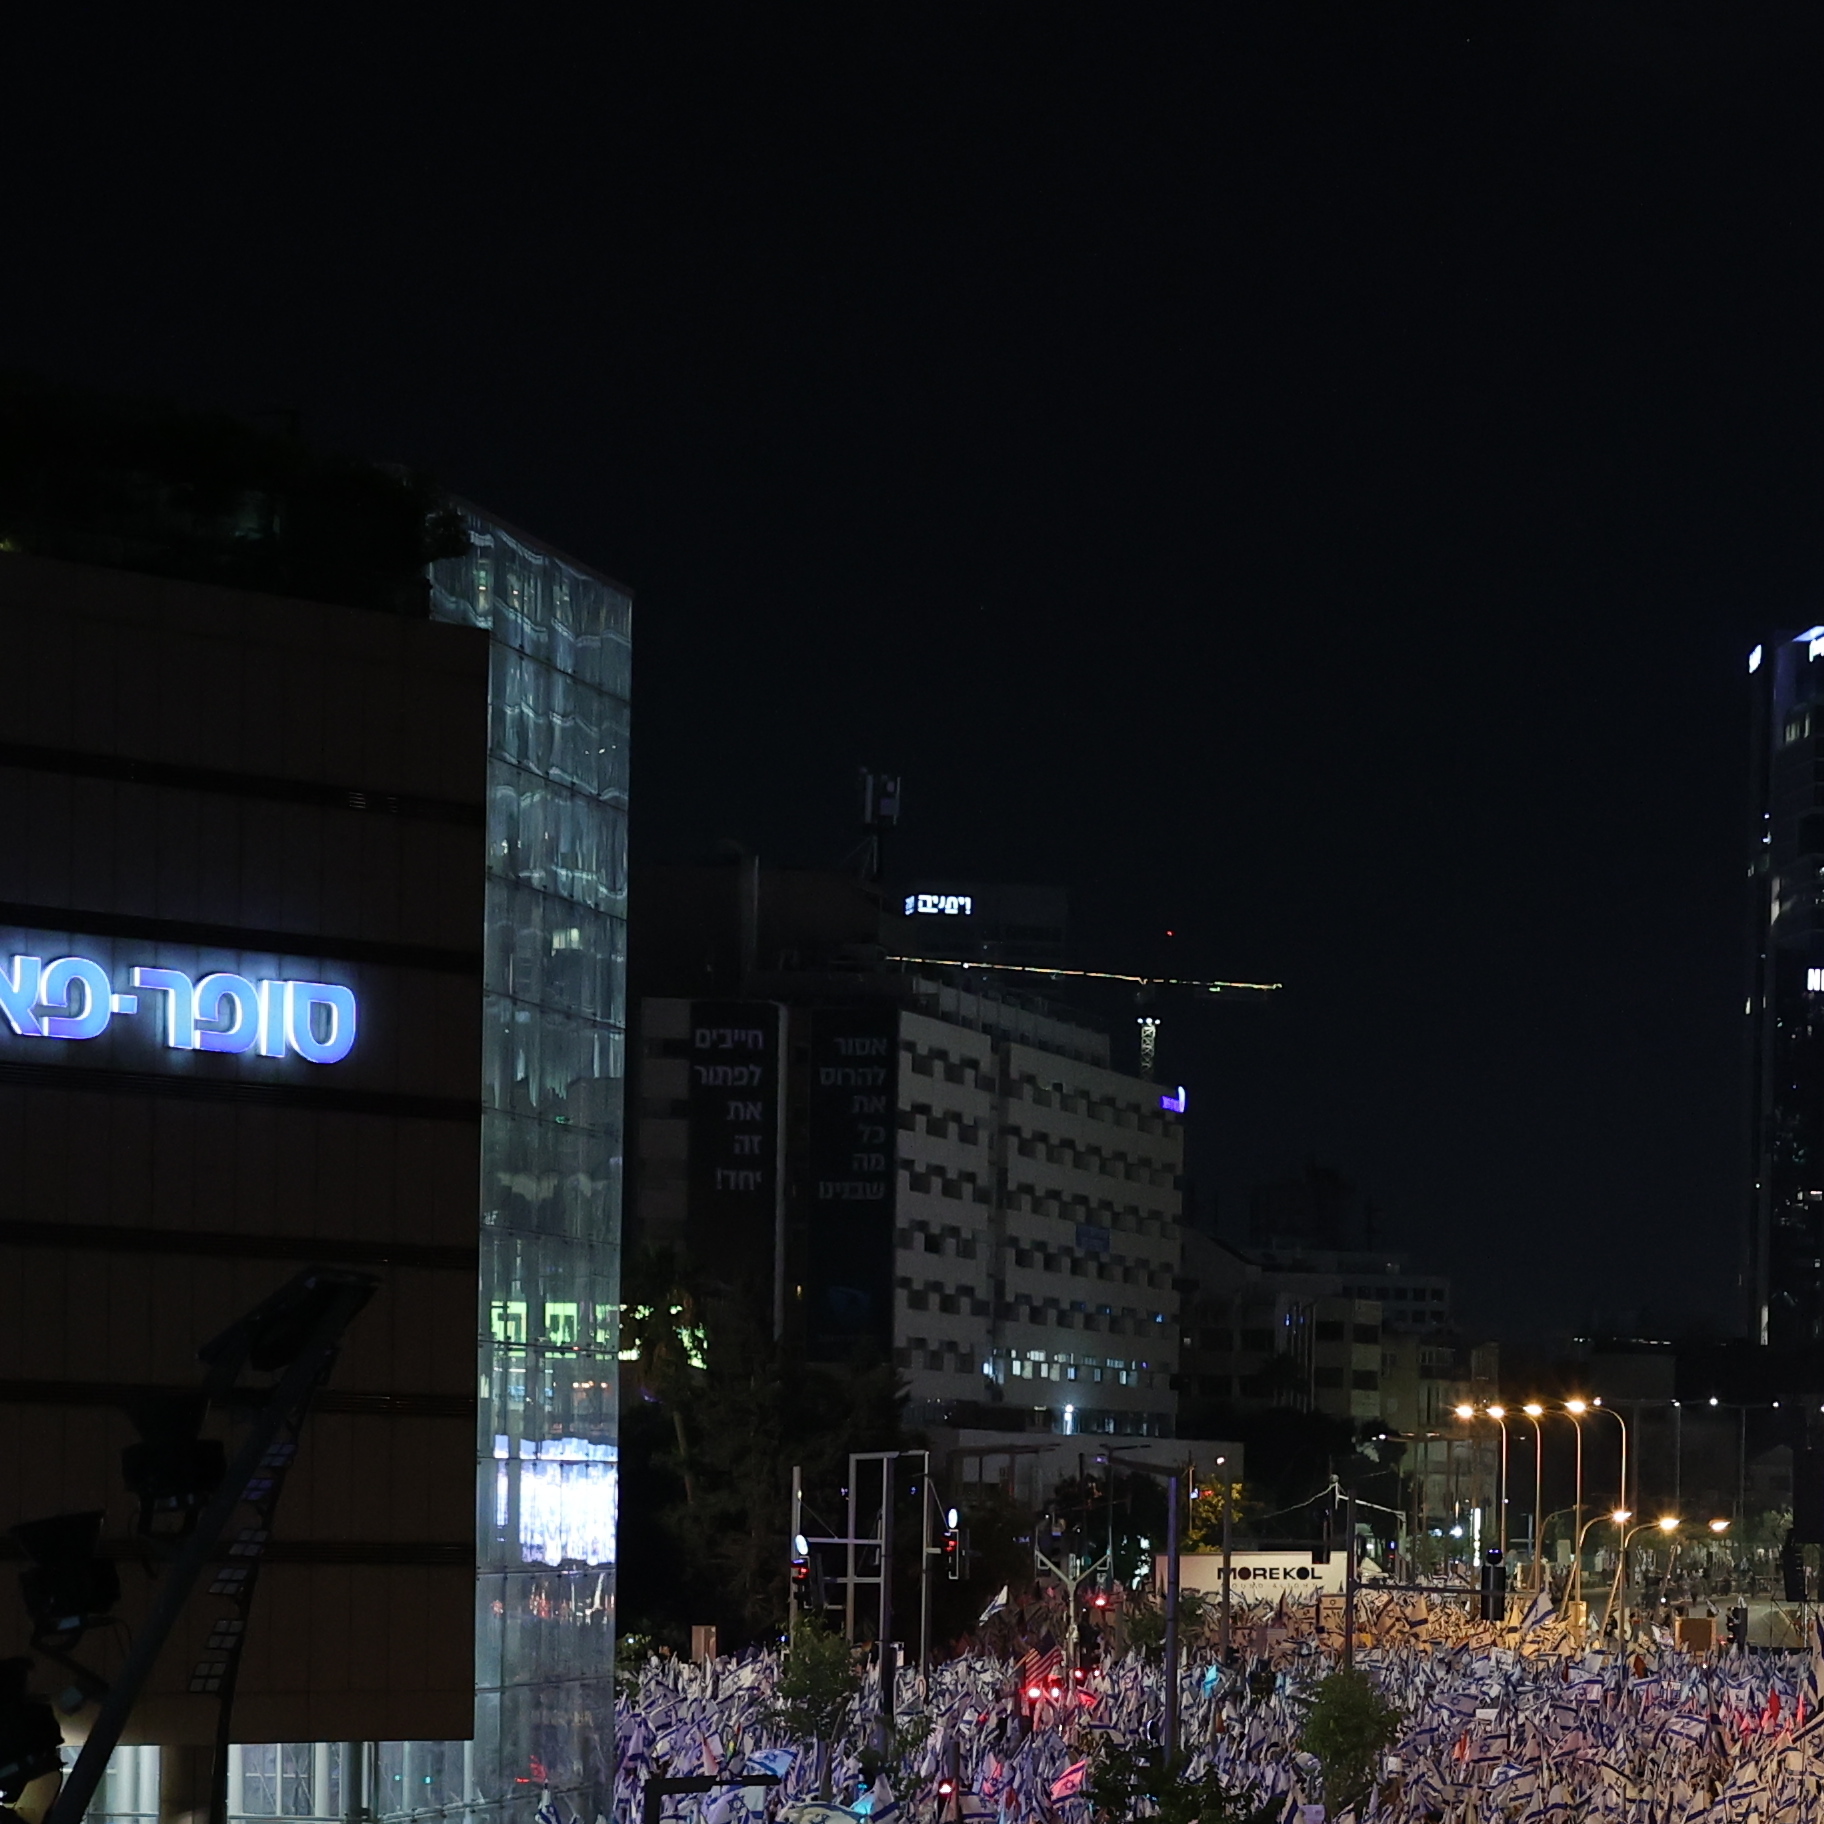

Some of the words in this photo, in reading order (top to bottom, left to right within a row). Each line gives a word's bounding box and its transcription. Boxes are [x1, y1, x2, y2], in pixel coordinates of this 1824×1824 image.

[694, 1027, 764, 1050] חייבים
[833, 1037, 888, 1057] אסור
[693, 1063, 763, 1087] לפתור
[818, 1065, 887, 1086] להרוס
[726, 1100, 763, 1121] את
[851, 1094, 886, 1113] את
[857, 1122, 886, 1144] כל
[733, 1133, 763, 1155] זה
[850, 1152, 886, 1171] מה
[715, 1166, 763, 1191] יחד!
[817, 1179, 885, 1200] שבנינו
